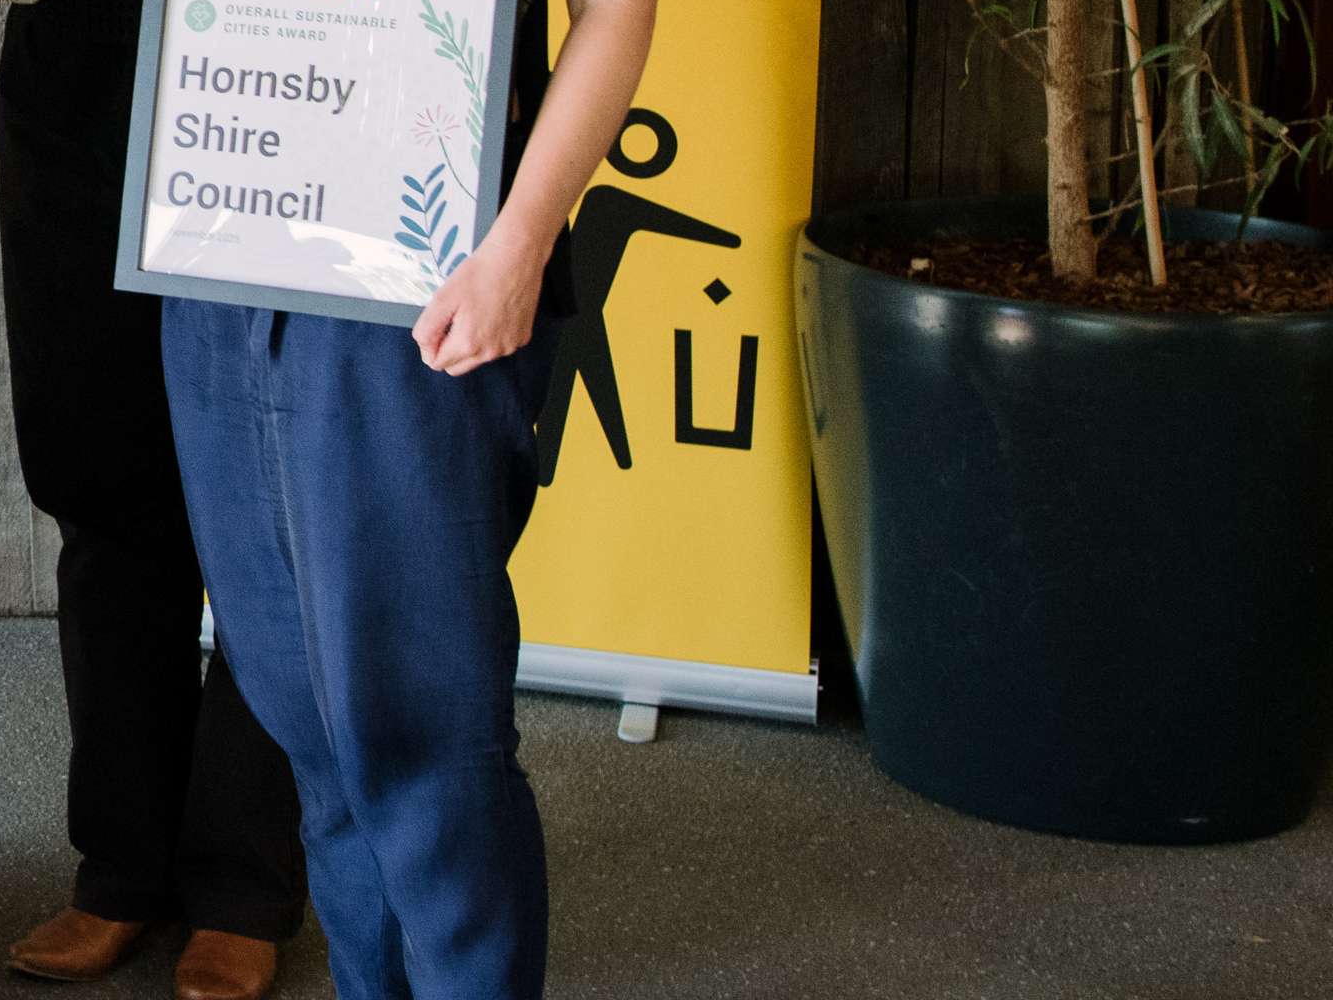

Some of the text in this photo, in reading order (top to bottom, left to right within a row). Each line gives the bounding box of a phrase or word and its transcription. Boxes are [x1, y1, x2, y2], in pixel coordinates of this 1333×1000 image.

[224, 23, 327, 42] CITIES AWARD
[226, 4, 398, 29] OVERALL SUSTAINABLE
[179, 55, 356, 115] Hornsby
[173, 113, 280, 157] Shire
[167, 171, 325, 222] Council
